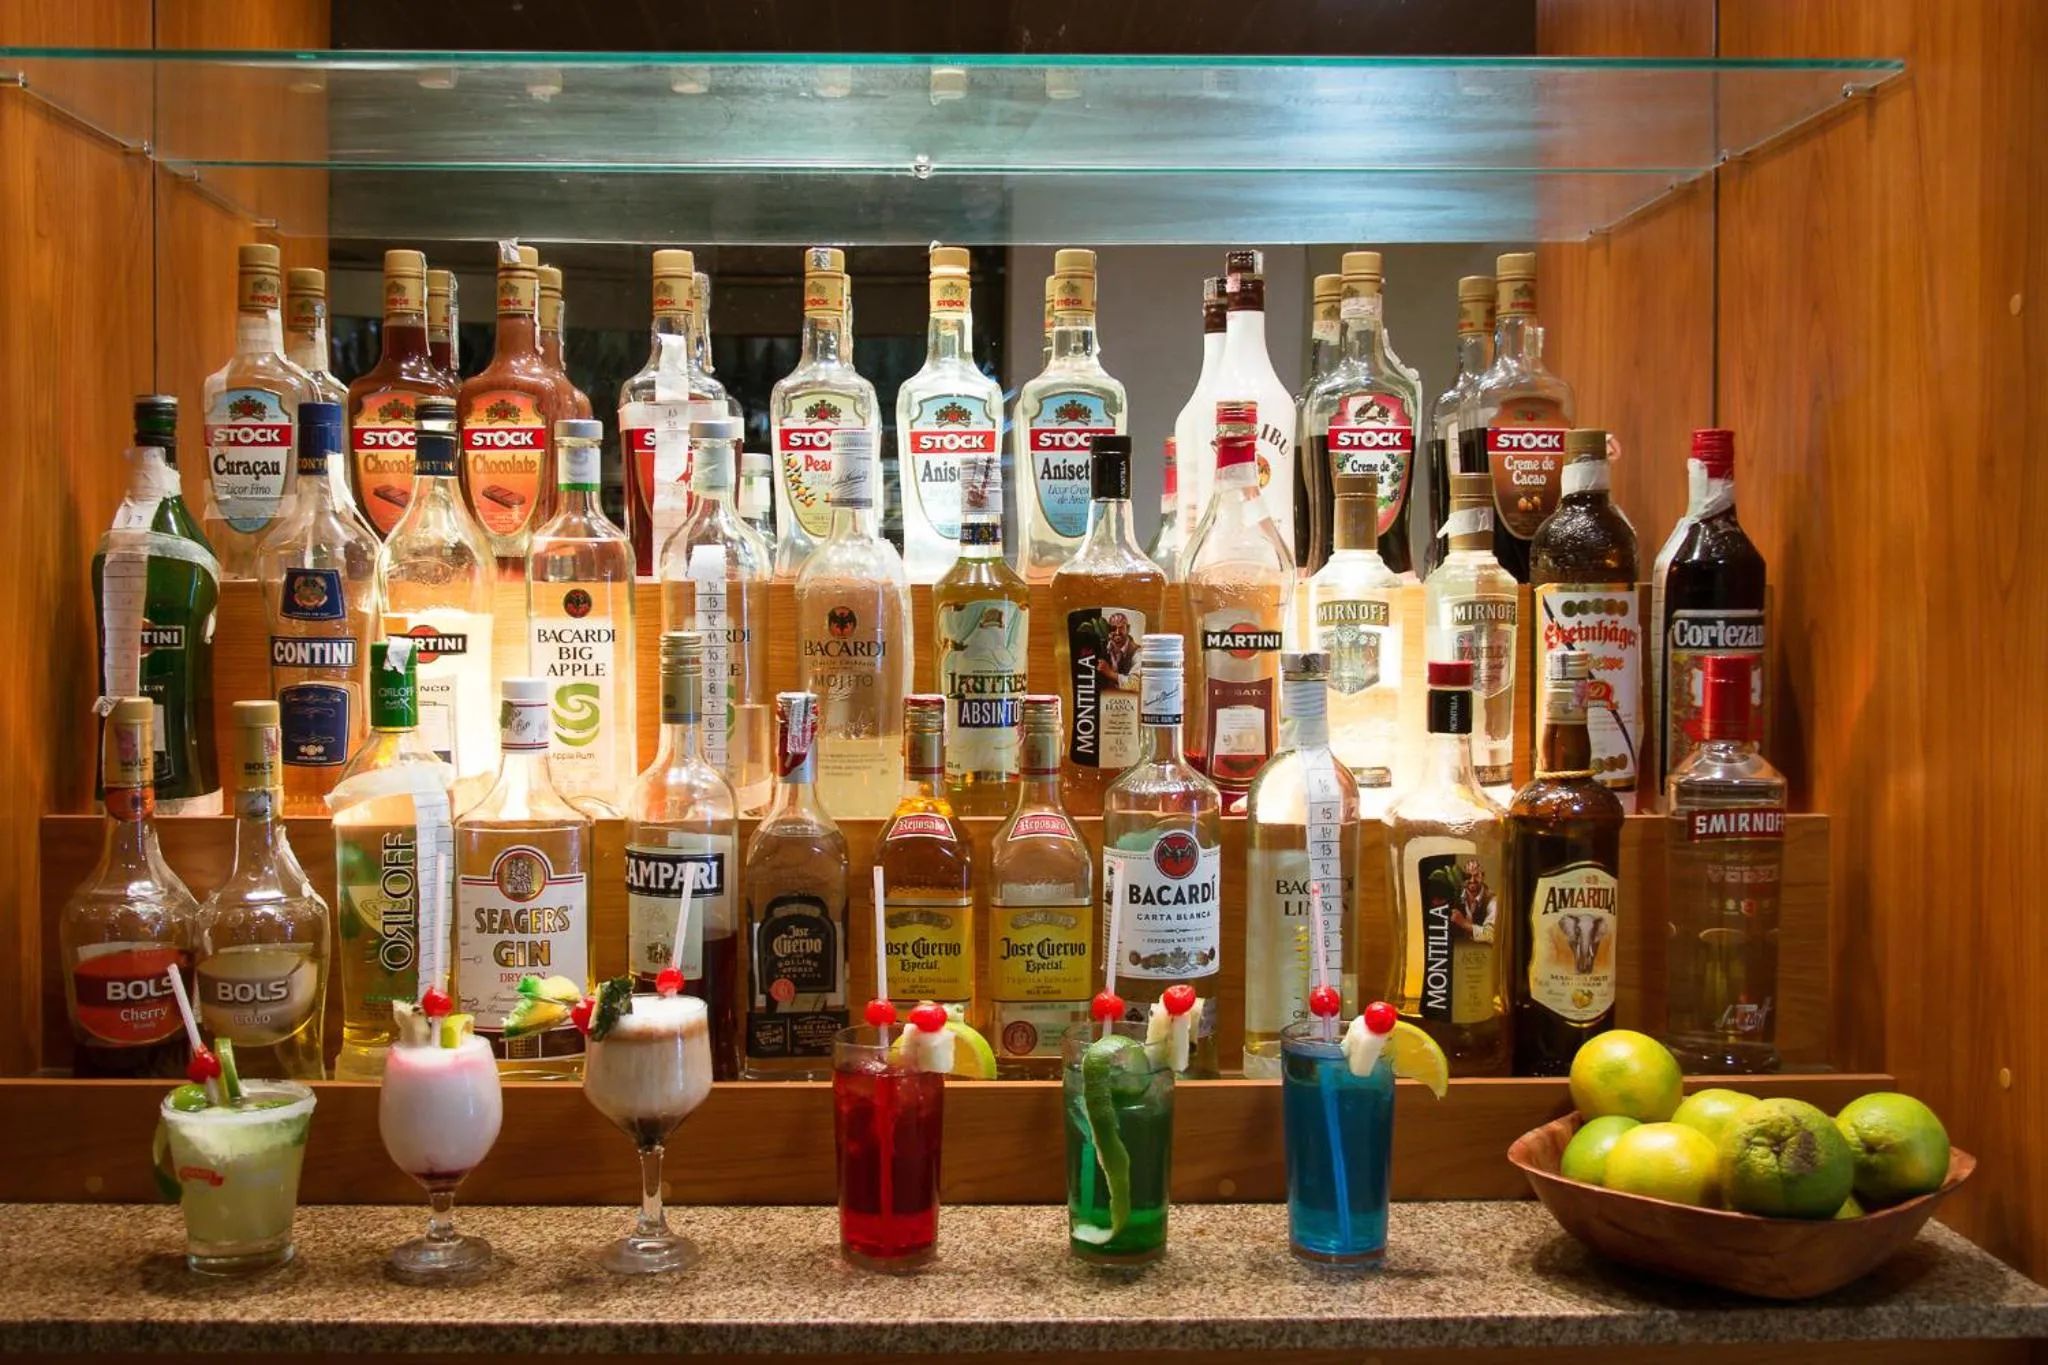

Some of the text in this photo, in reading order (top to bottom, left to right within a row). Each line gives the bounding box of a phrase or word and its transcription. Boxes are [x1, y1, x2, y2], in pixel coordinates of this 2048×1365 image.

[937, 299, 965, 307] STOCK
[214, 428, 280, 444] STOCK
[363, 431, 416, 447] STOC
[472, 431, 534, 447] STOCK
[789, 431, 831, 447] STO
[919, 434, 985, 450] STOCK
[1337, 432, 1402, 448] STOCK
[1497, 433, 1560, 449] STOCK
[213, 455, 281, 480] Curaçau
[472, 454, 537, 475] Chocolate
[804, 455, 831, 473] Pea
[1040, 458, 1089, 481] Aniset
[1351, 459, 1390, 472] Creme de
[1504, 456, 1555, 470] Creme de
[921, 460, 960, 483] Anis
[1512, 471, 1547, 486] Cacao
[1317, 603, 1388, 621] MIRNOFF
[142, 631, 178, 645] TINI
[417, 637, 463, 651] RTINI
[537, 628, 616, 644] BACARDI
[1207, 634, 1280, 647] MARTINI
[273, 641, 354, 665] CONTINI
[558, 646, 593, 660] BIG
[804, 640, 887, 657] BACARDI
[546, 662, 606, 677] APPLE
[1076, 654, 1096, 754] MONTILLA
[961, 700, 1019, 725] ABSINTO
[899, 818, 945, 832] Reposado
[1019, 818, 1066, 831] Reposado
[1695, 812, 1786, 835] SMIRNOF
[1320, 863, 1331, 876] 12
[1128, 877, 1216, 905] BACARDÍ
[1542, 886, 1617, 916] AMARULA
[474, 905, 570, 934] SEAGERS
[1136, 911, 1211, 921] CARTA BLANCA
[772, 932, 822, 957] Cuervo
[885, 936, 961, 959] ose Cuervo
[1000, 937, 1086, 960] Jose Cuervo
[492, 940, 552, 967] GIN
[1426, 903, 1450, 1010] MONTILLA
[500, 973, 521, 983] DRY
[106, 977, 175, 1001] BOLS
[217, 980, 289, 1001] BOLS
[120, 1005, 168, 1022] Cherry
